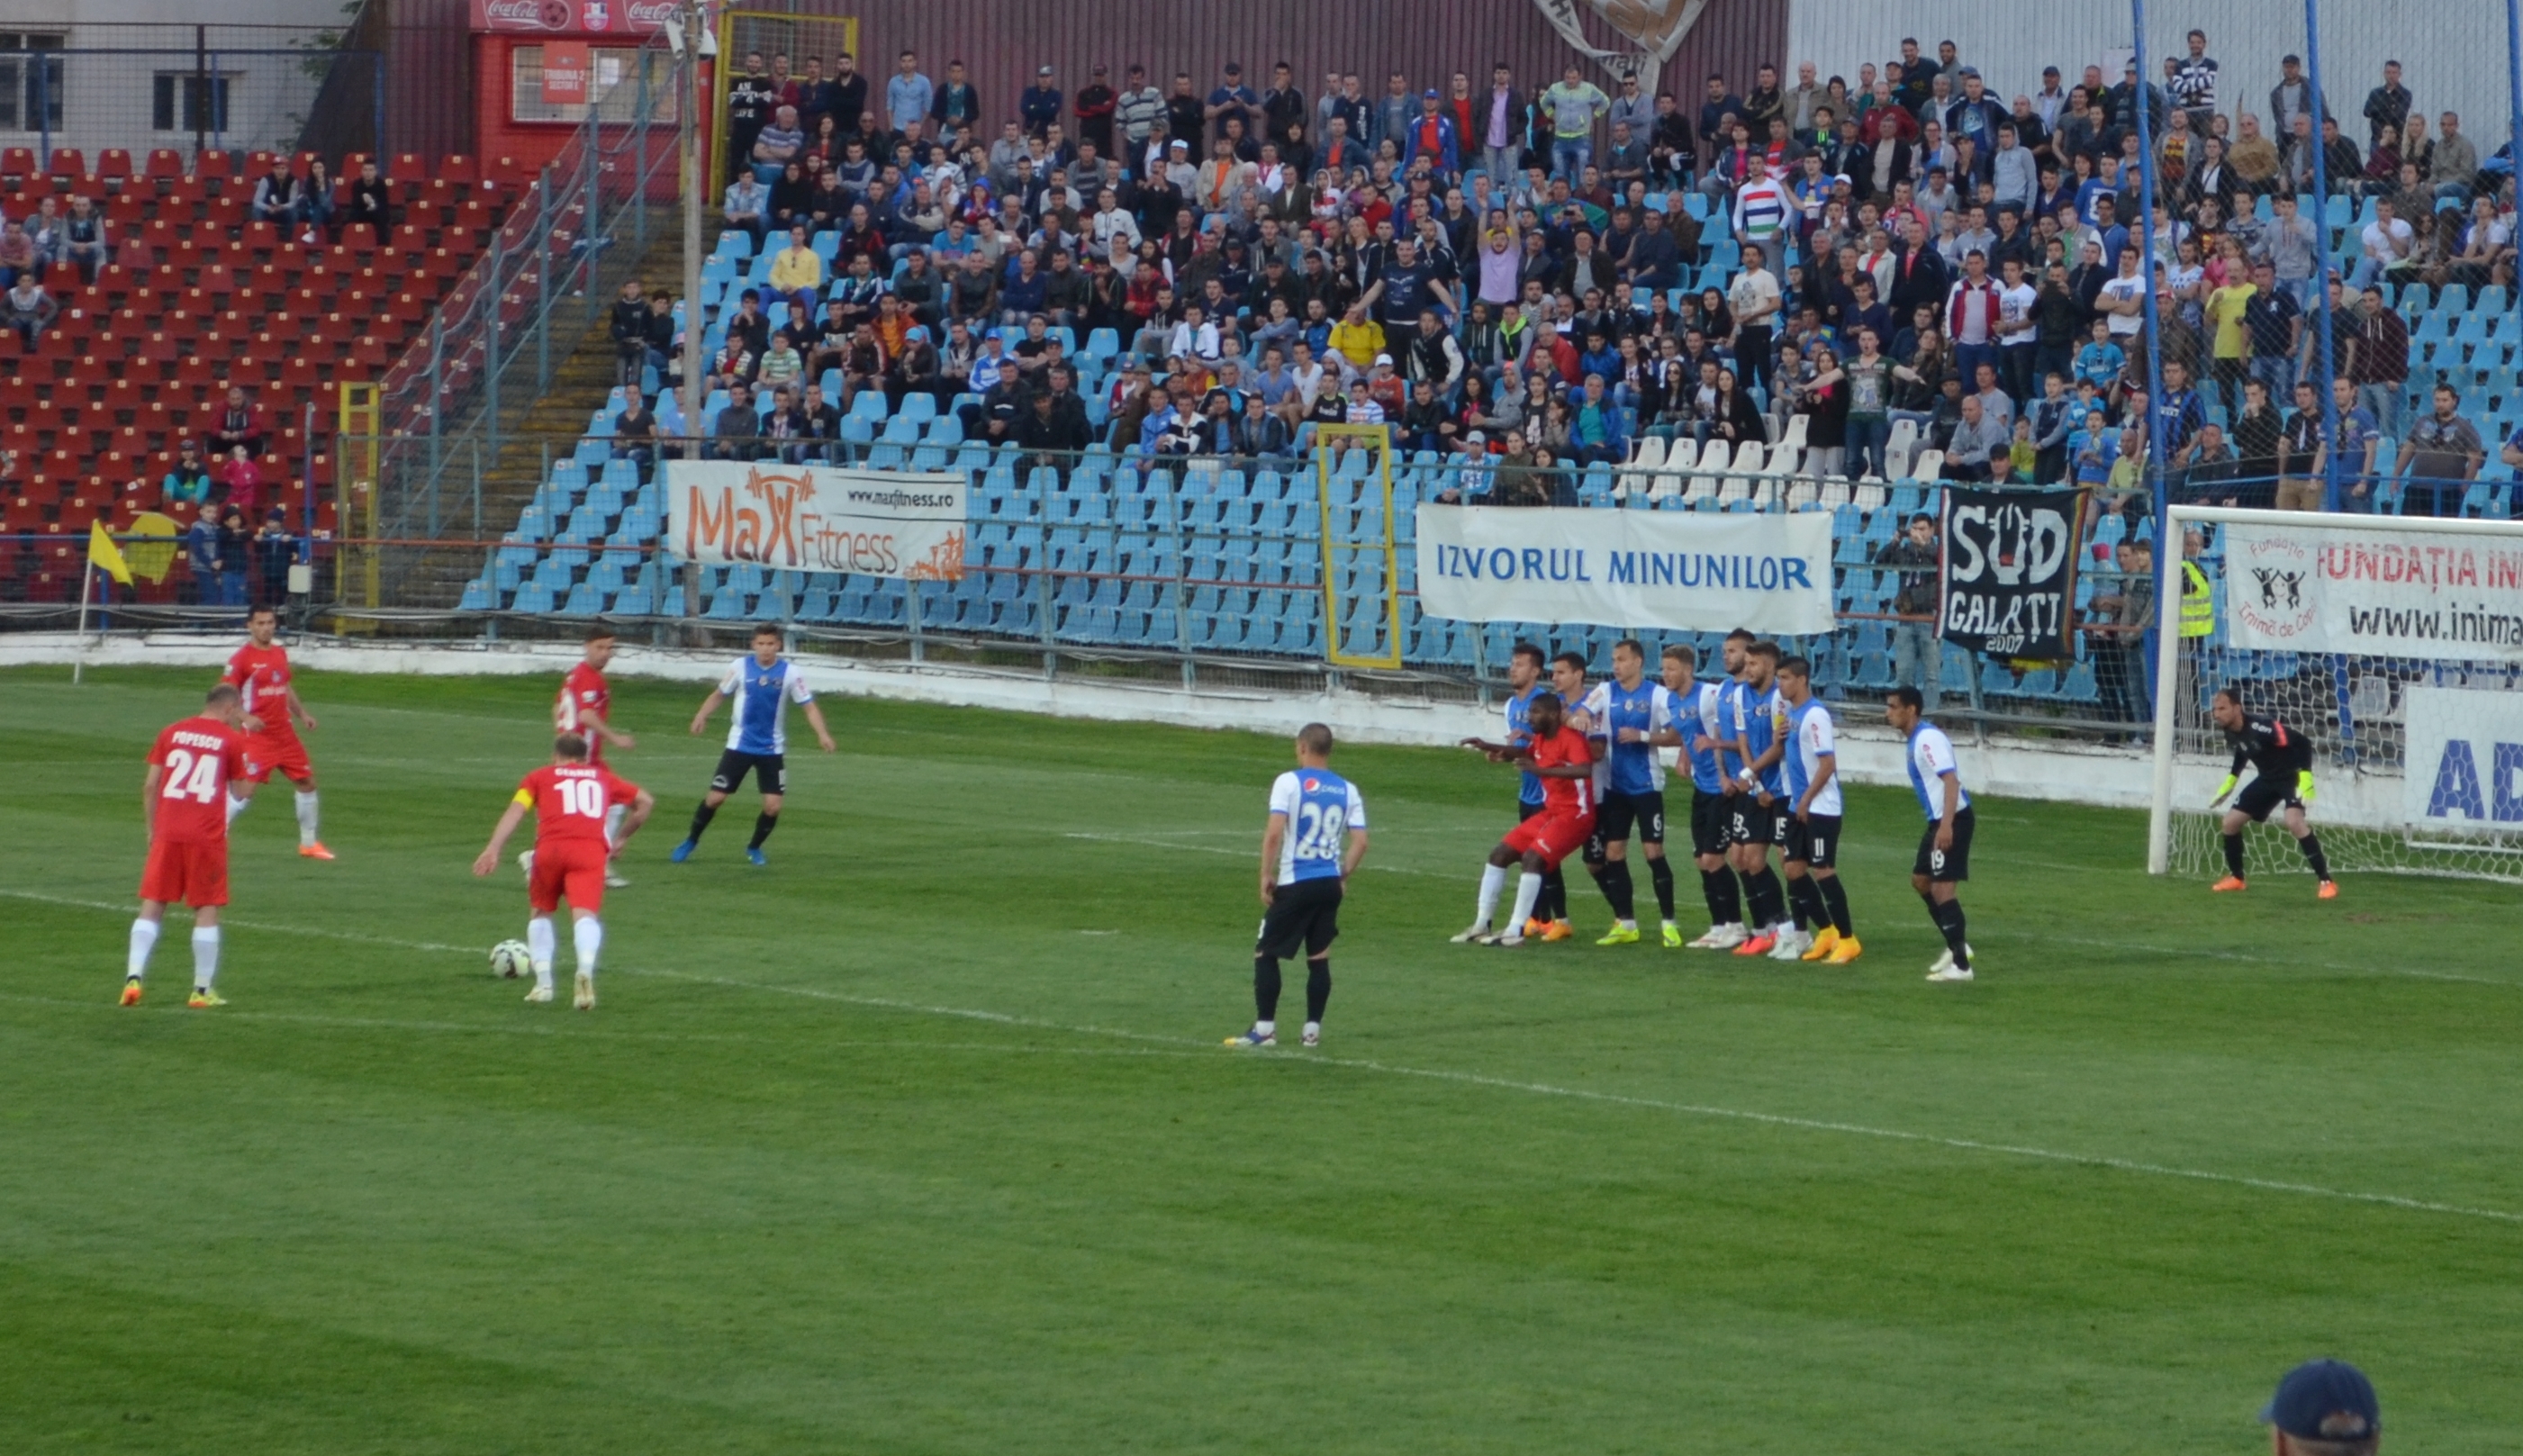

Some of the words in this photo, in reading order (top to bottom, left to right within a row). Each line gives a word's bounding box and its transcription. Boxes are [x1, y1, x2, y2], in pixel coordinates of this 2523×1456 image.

[579, 69, 585, 81] 2
[847, 489, 954, 511] www.maxfitness.ro
[800, 513, 898, 574] Fitness
[1952, 502, 2068, 585] SUD
[1437, 544, 1591, 582] IZVORUL
[1608, 550, 1813, 591] MINUNILOR
[2278, 621, 2294, 638] de
[1985, 635, 2025, 654] 2007
[172, 730, 224, 752] POPESCU
[163, 748, 220, 804] 24
[554, 779, 602, 818] 10
[1295, 801, 1345, 860] 28
[1653, 813, 1662, 832] 6
[1814, 837, 1825, 857] 11
[1931, 849, 1946, 871] 19
